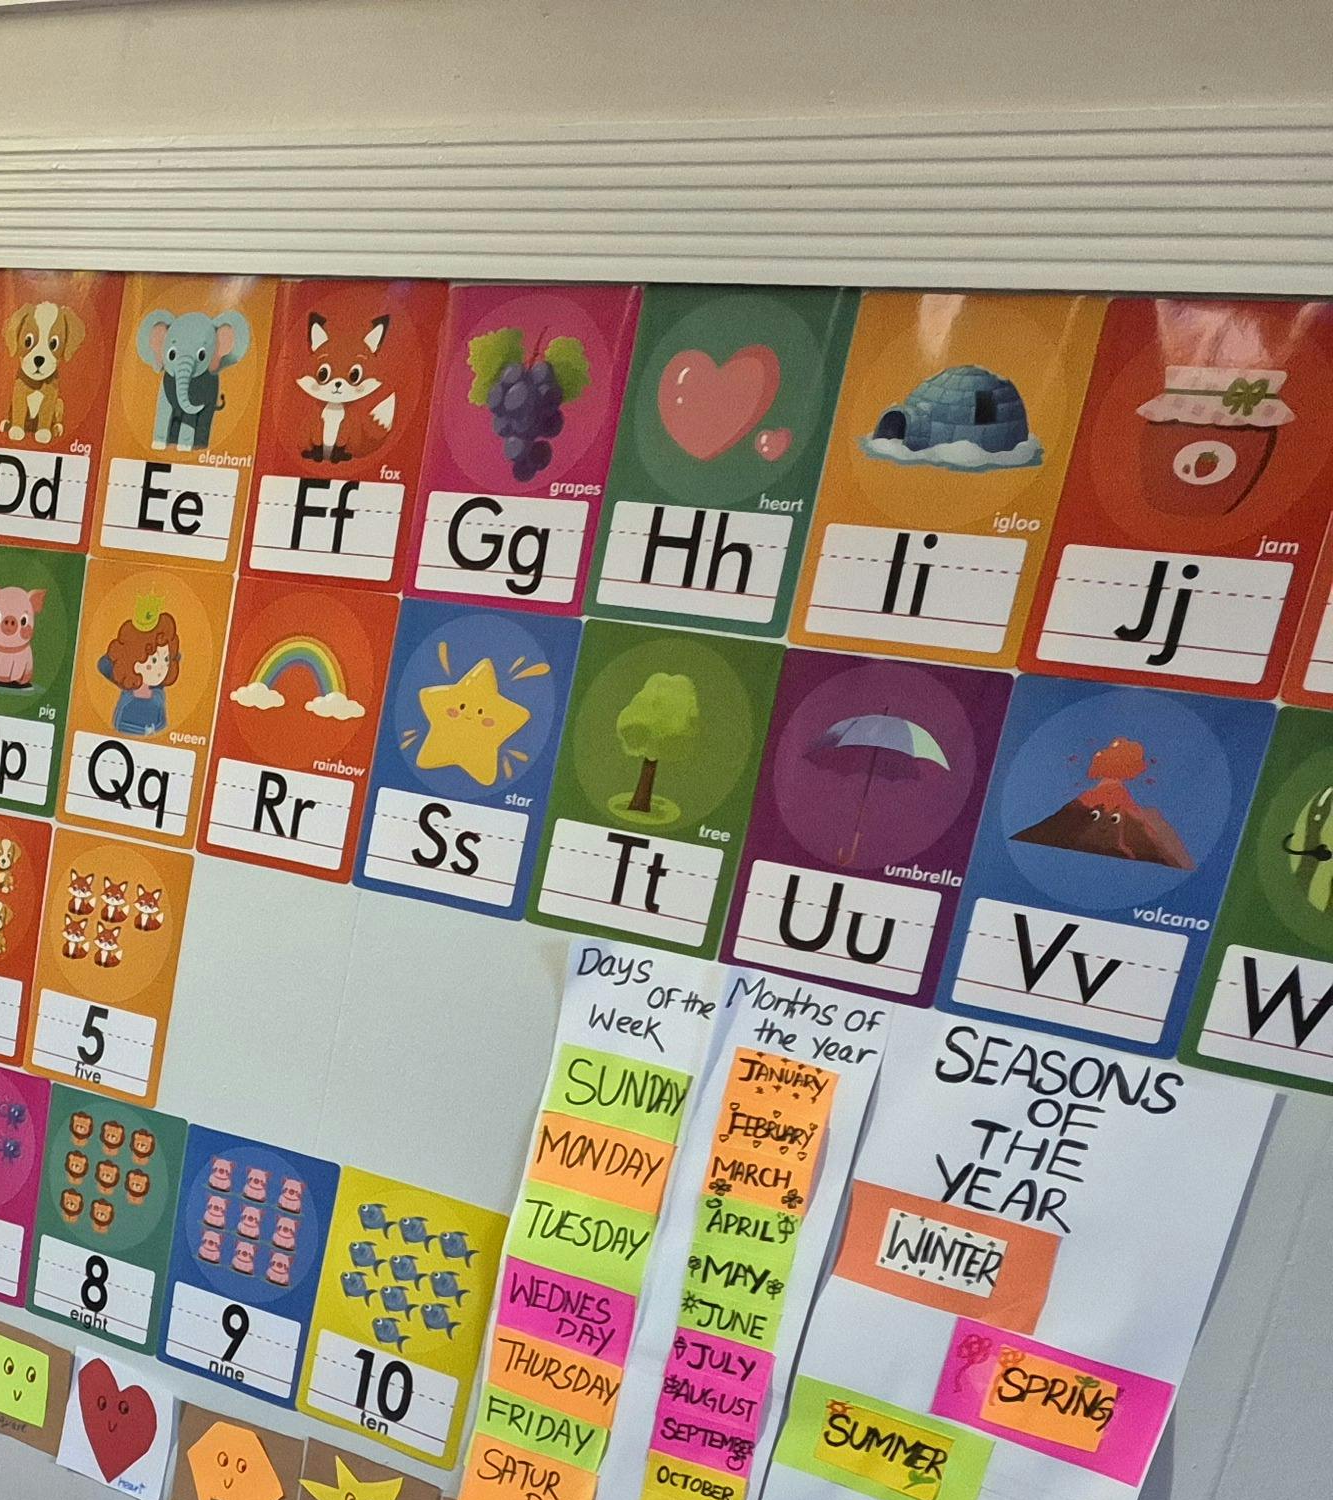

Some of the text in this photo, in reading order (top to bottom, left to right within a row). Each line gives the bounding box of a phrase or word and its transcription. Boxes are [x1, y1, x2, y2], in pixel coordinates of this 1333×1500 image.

[70, 440, 91, 455] dog
[198, 451, 252, 467] elephant
[379, 465, 400, 481] fox
[549, 480, 602, 497] grapes
[137, 461, 204, 536] Ee
[290, 477, 360, 554] Ff
[759, 494, 804, 513] heart
[992, 512, 1041, 533] igloo
[448, 497, 551, 596] Gg
[641, 506, 754, 595] Hh
[1256, 537, 1299, 558] jam
[1114, 560, 1200, 667] Jj
[39, 704, 56, 719] pig
[169, 731, 206, 747] queen
[88, 740, 170, 828] Qq
[312, 758, 365, 778] rainbow
[253, 770, 316, 839] Rr
[505, 792, 532, 808] star
[411, 802, 481, 876] Ss
[698, 826, 731, 843] tree
[607, 831, 668, 914] Tt
[884, 863, 962, 888] umbrella
[777, 872, 895, 965] Uu
[1133, 906, 1210, 932] volcano
[576, 948, 654, 985] Days
[1012, 913, 1122, 1005] Vv
[76, 1004, 106, 1066] 5
[589, 1004, 665, 1052] Week
[74, 1062, 103, 1085] five
[563, 1057, 688, 1115] SUNDAY
[739, 1057, 828, 1096] JANUARY
[935, 1025, 1184, 1115] SEASONS
[729, 1111, 816, 1149] FEBRUARY
[1027, 1097, 1106, 1135] OF
[535, 1125, 665, 1187] MONDAY
[711, 1156, 793, 1189] MARCH
[971, 1119, 1093, 1183] THE
[935, 1154, 1072, 1234] YEAR
[525, 1198, 650, 1260] TUESDAY
[706, 1208, 773, 1243] APRIL
[886, 1219, 1003, 1287] WINTER
[81, 1254, 110, 1315] 8
[510, 1272, 612, 1324] WEDNES
[700, 1260, 771, 1295] MAY
[69, 1307, 108, 1333] eight
[221, 1303, 250, 1362] 9
[555, 1317, 615, 1356] DAY
[697, 1302, 767, 1340] JUNE
[209, 1359, 245, 1383] nine
[497, 1337, 620, 1406] THURSDAY
[686, 1342, 757, 1382] JULY
[355, 1348, 413, 1423] 10
[676, 1379, 758, 1422] AUGUST
[997, 1367, 1118, 1432] SPRING
[359, 1412, 389, 1436] ten
[486, 1396, 594, 1456] FRIDAY
[660, 1418, 755, 1456] SEPTEMBER
[823, 1413, 948, 1480] SUMMER
[477, 1449, 561, 1500] SATUR
